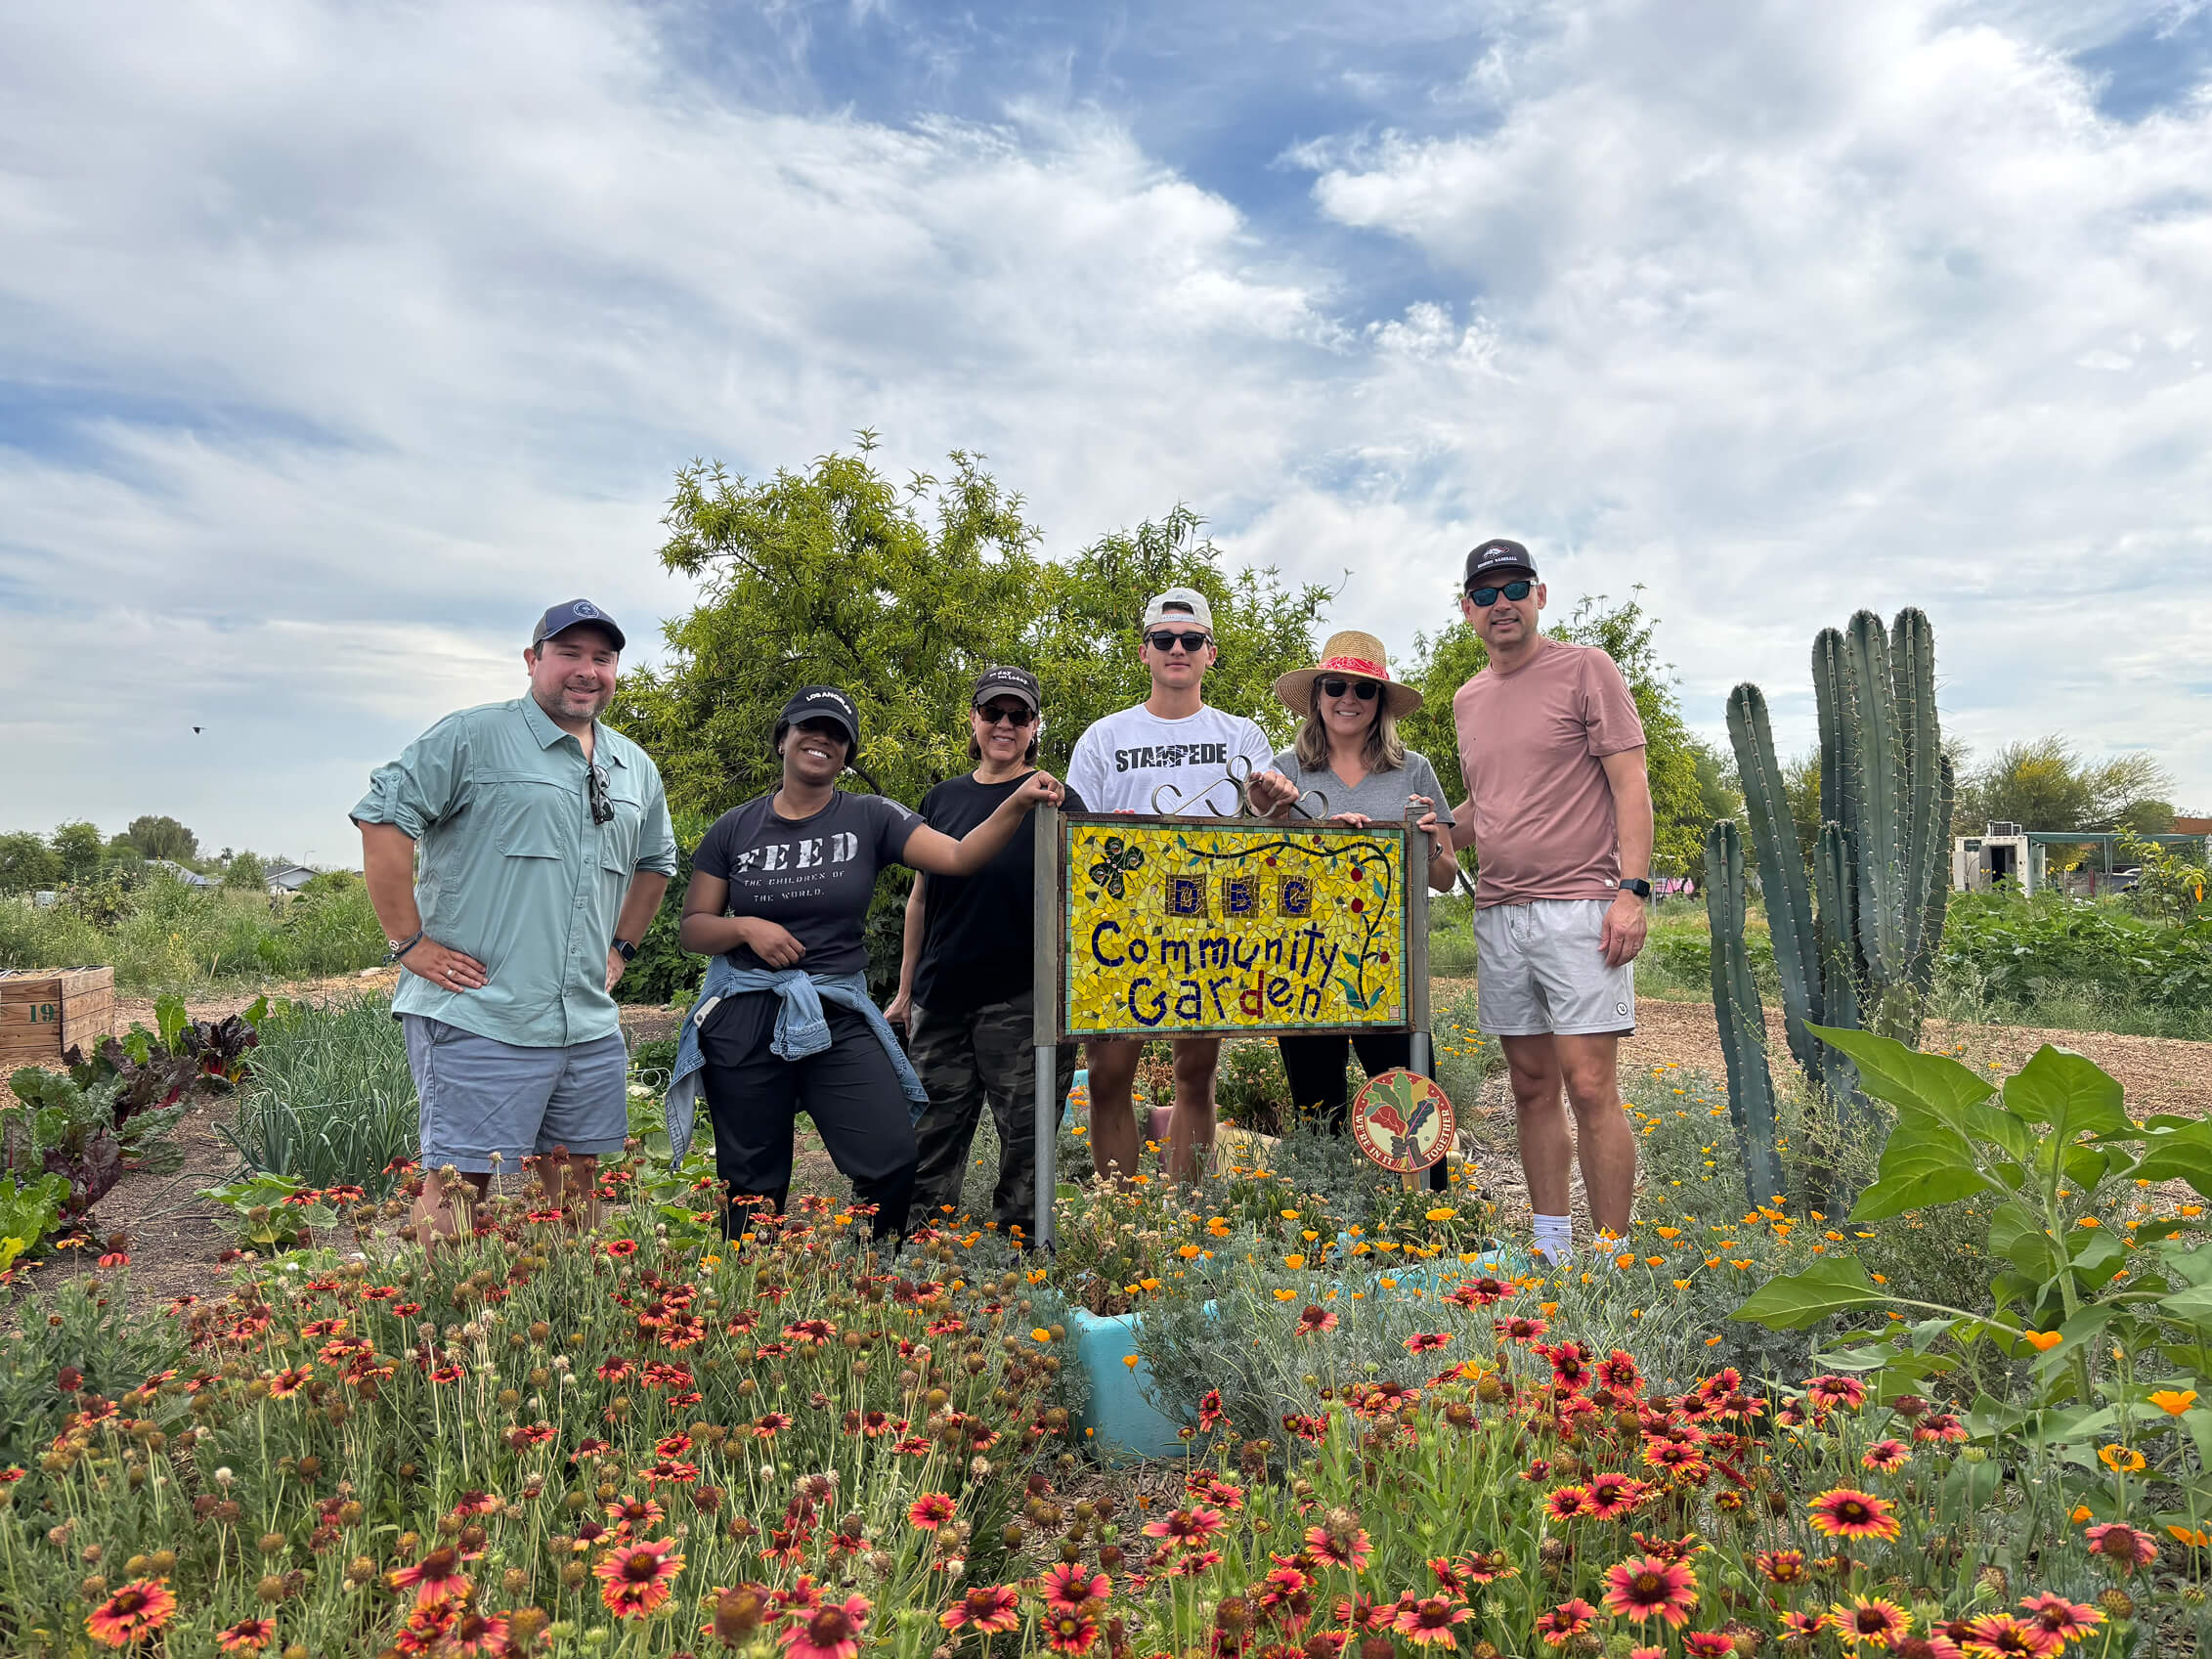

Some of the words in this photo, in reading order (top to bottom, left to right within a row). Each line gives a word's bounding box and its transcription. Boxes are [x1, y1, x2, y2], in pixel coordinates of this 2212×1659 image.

[1114, 743, 1228, 772] STAMPEDE
[736, 832, 858, 873] FEED
[768, 872, 826, 886] CHILDREN
[1092, 920, 1339, 988] Community
[29, 1003, 56, 1024] 19
[1128, 970, 1322, 1026] Garden
[1355, 1114, 1371, 1148] WE'RE
[1368, 1147, 1382, 1159] IN
[1381, 1156, 1395, 1166] IT
[1424, 1109, 1452, 1161] TOGETHER
